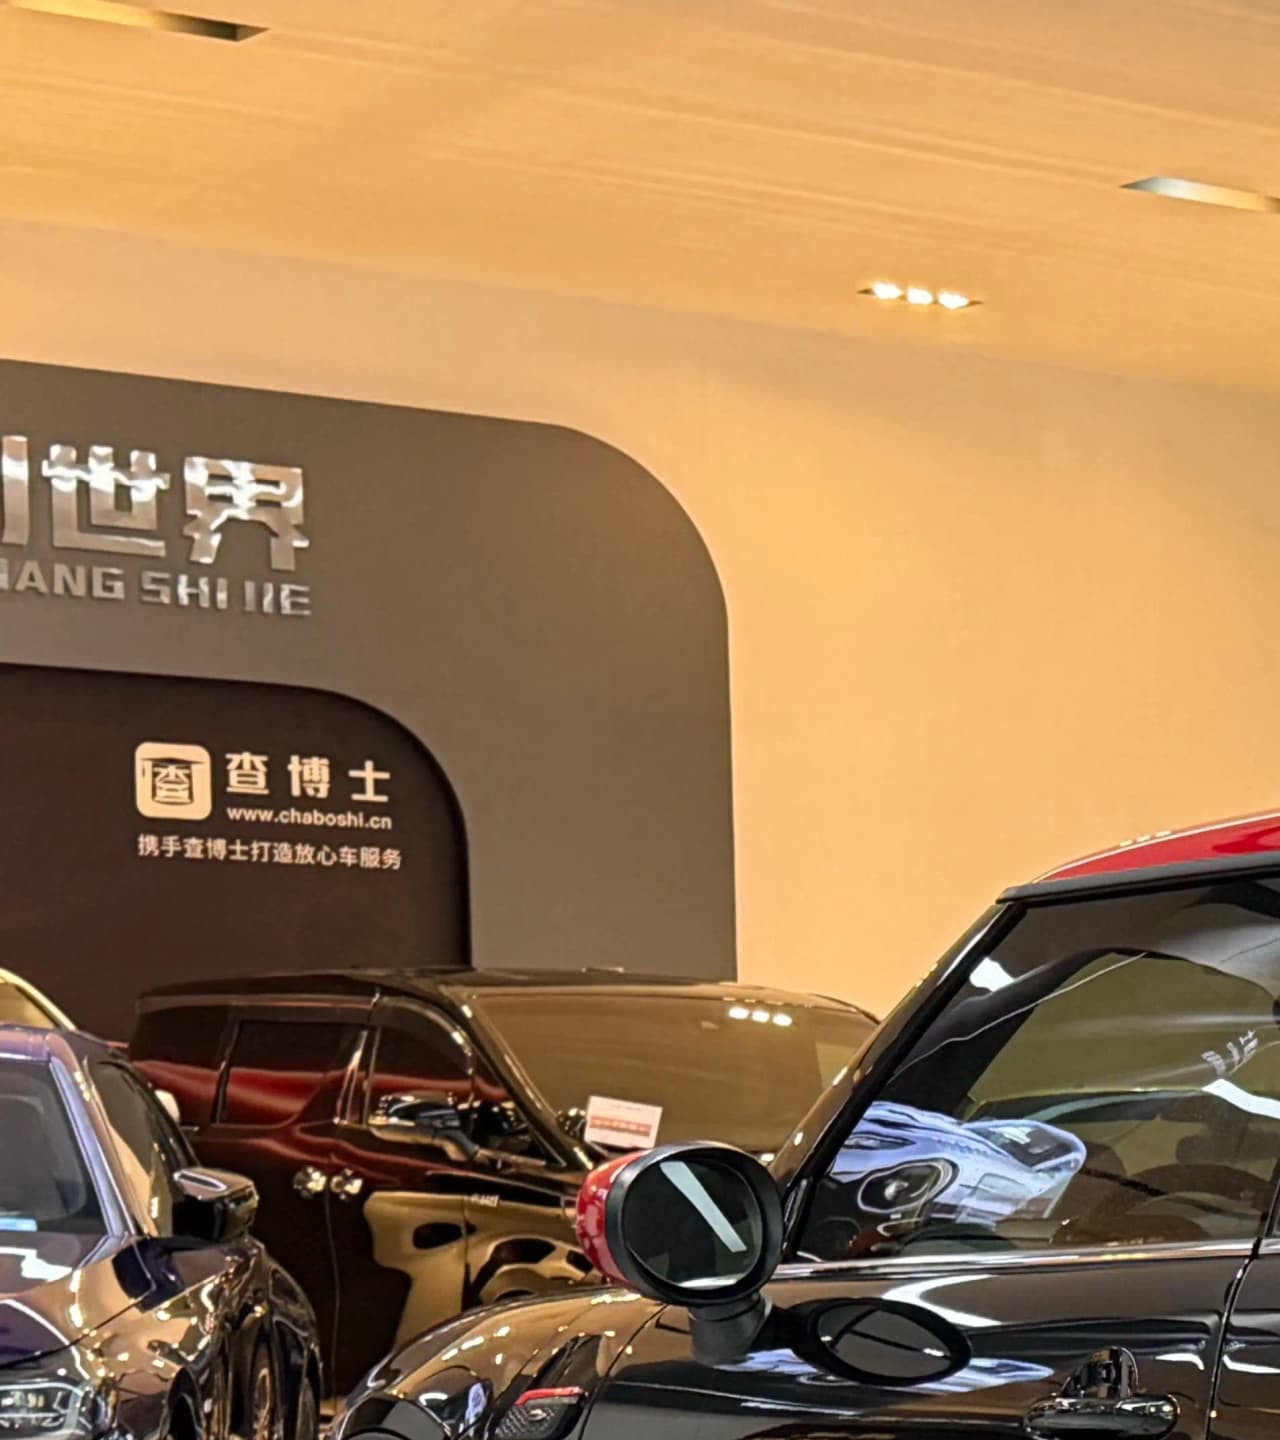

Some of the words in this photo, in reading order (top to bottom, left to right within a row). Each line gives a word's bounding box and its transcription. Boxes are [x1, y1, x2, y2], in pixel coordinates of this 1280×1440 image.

[0, 558, 125, 600] ANG
[141, 570, 228, 610] SHI
[225, 752, 391, 802] 查博士
[226, 807, 392, 830] www.chaboshi.cn
[137, 834, 402, 871] 携手查博士打造放心车服务
